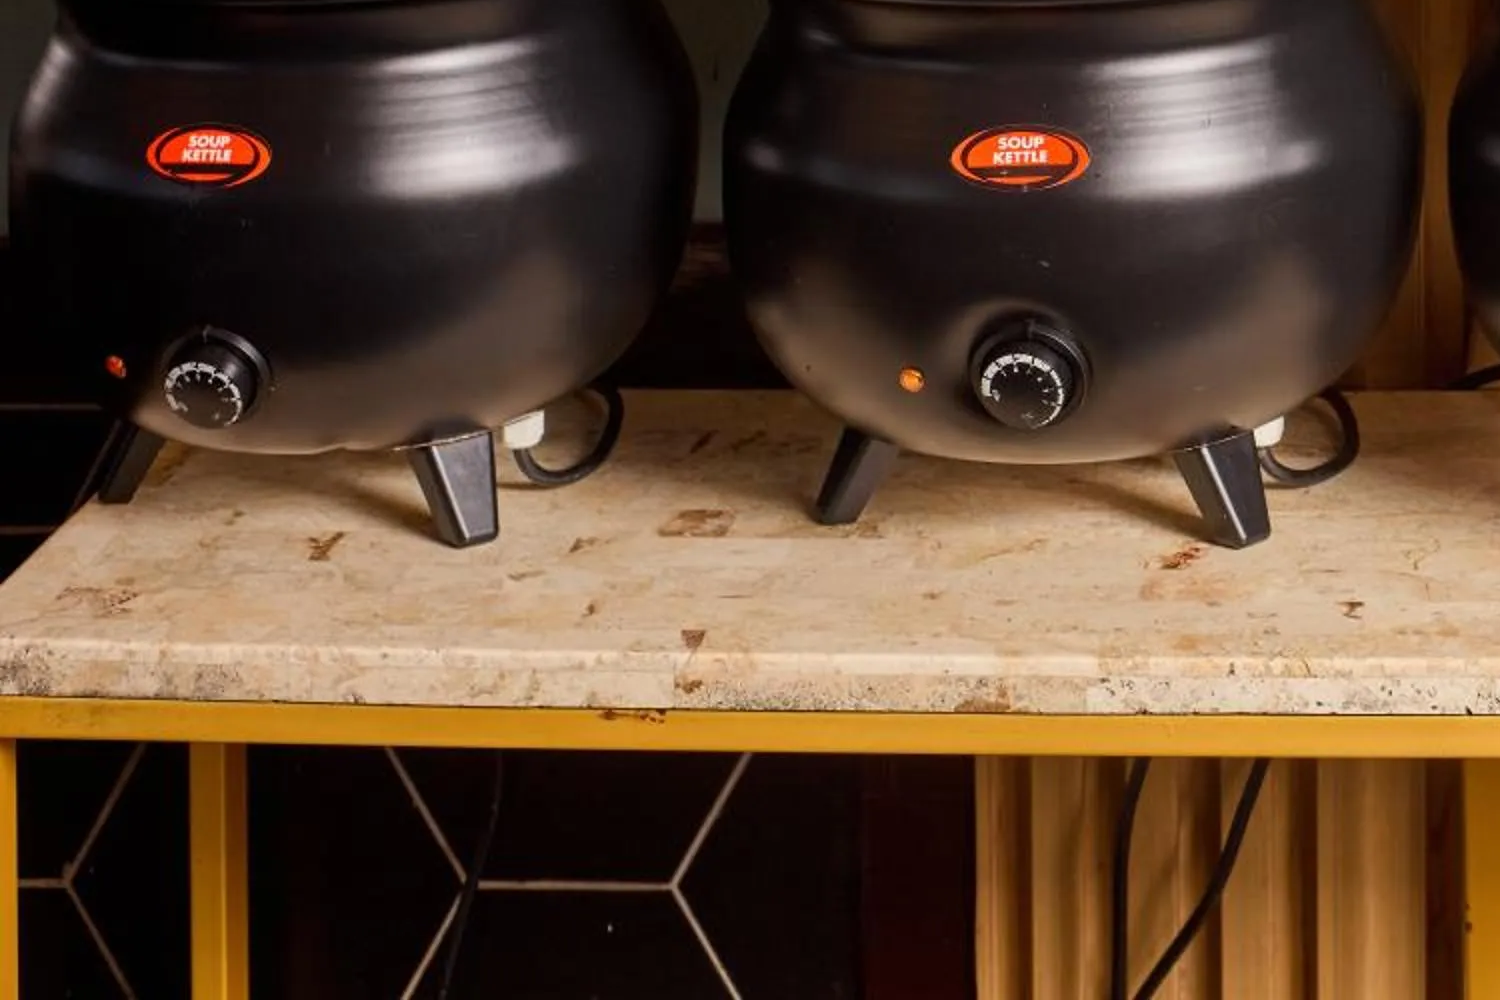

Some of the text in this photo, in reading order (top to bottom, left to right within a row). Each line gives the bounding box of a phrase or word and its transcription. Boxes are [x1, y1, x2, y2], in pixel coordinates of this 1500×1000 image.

[188, 135, 231, 148] SOUP
[997, 135, 1045, 150] SOUP
[182, 149, 232, 163] KETTLE
[992, 150, 1048, 166] KETTLE
